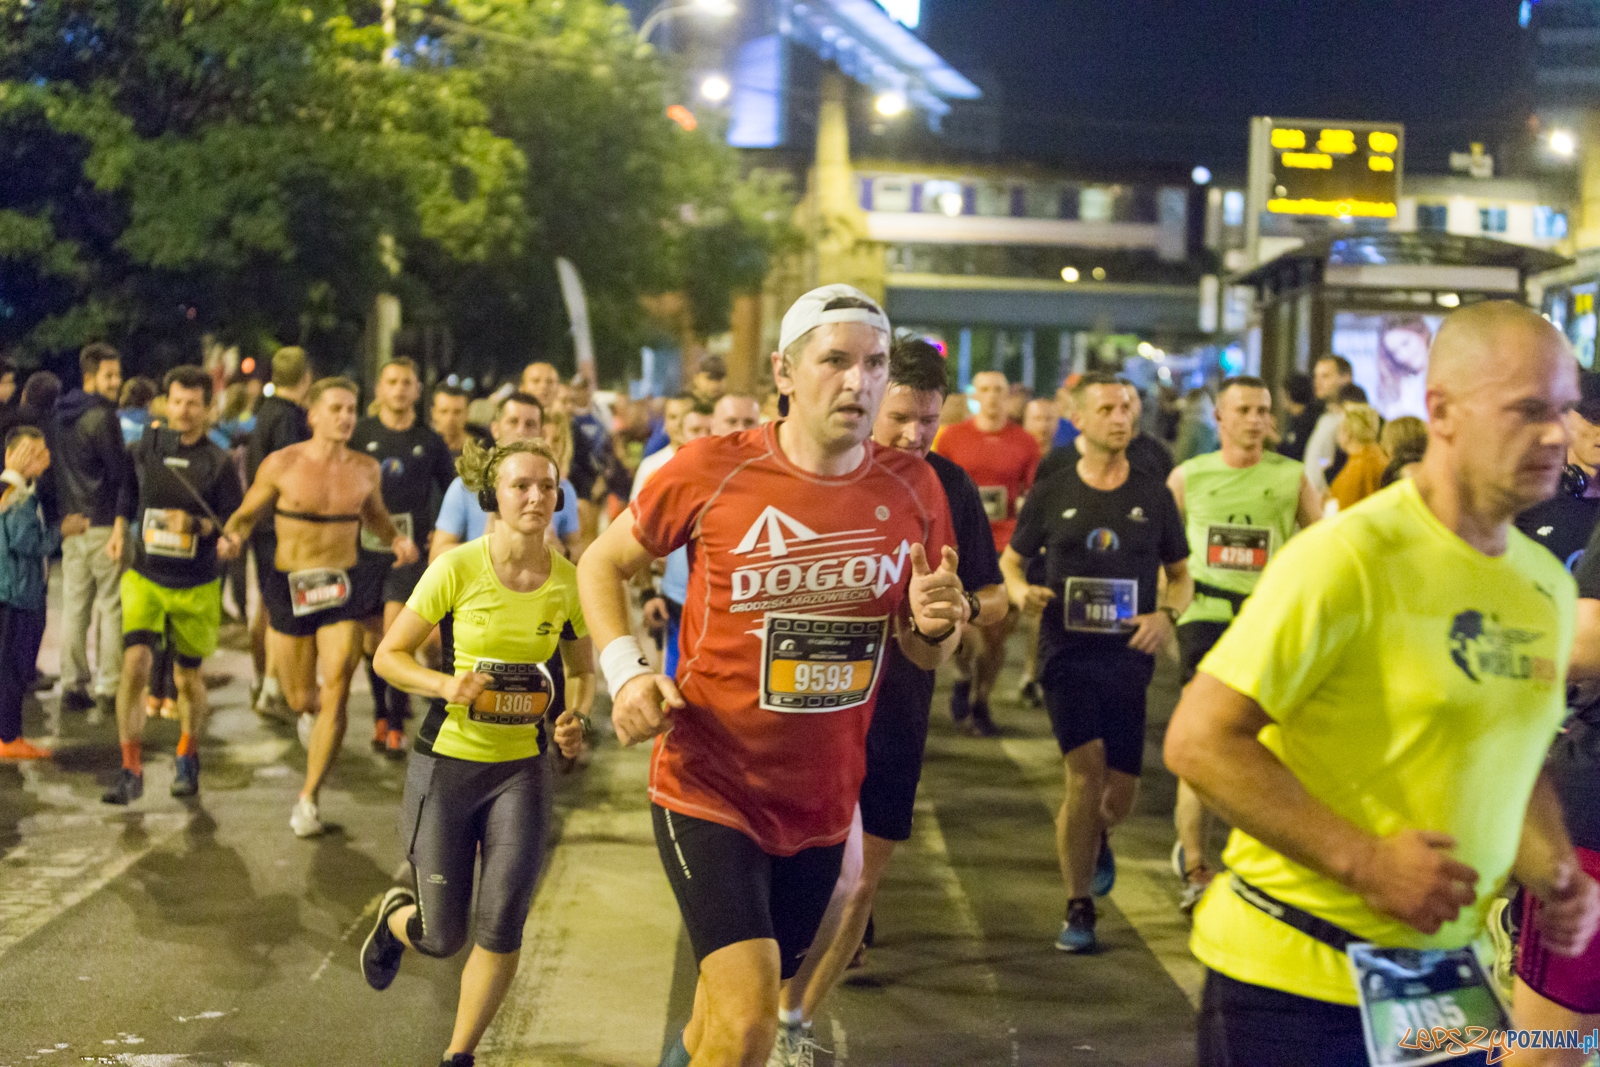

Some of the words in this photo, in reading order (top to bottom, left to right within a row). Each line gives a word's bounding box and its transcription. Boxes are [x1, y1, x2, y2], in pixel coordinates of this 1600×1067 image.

[731, 539, 911, 601] DOGON
[794, 663, 854, 691] 9593
[494, 693, 533, 713] 1306
